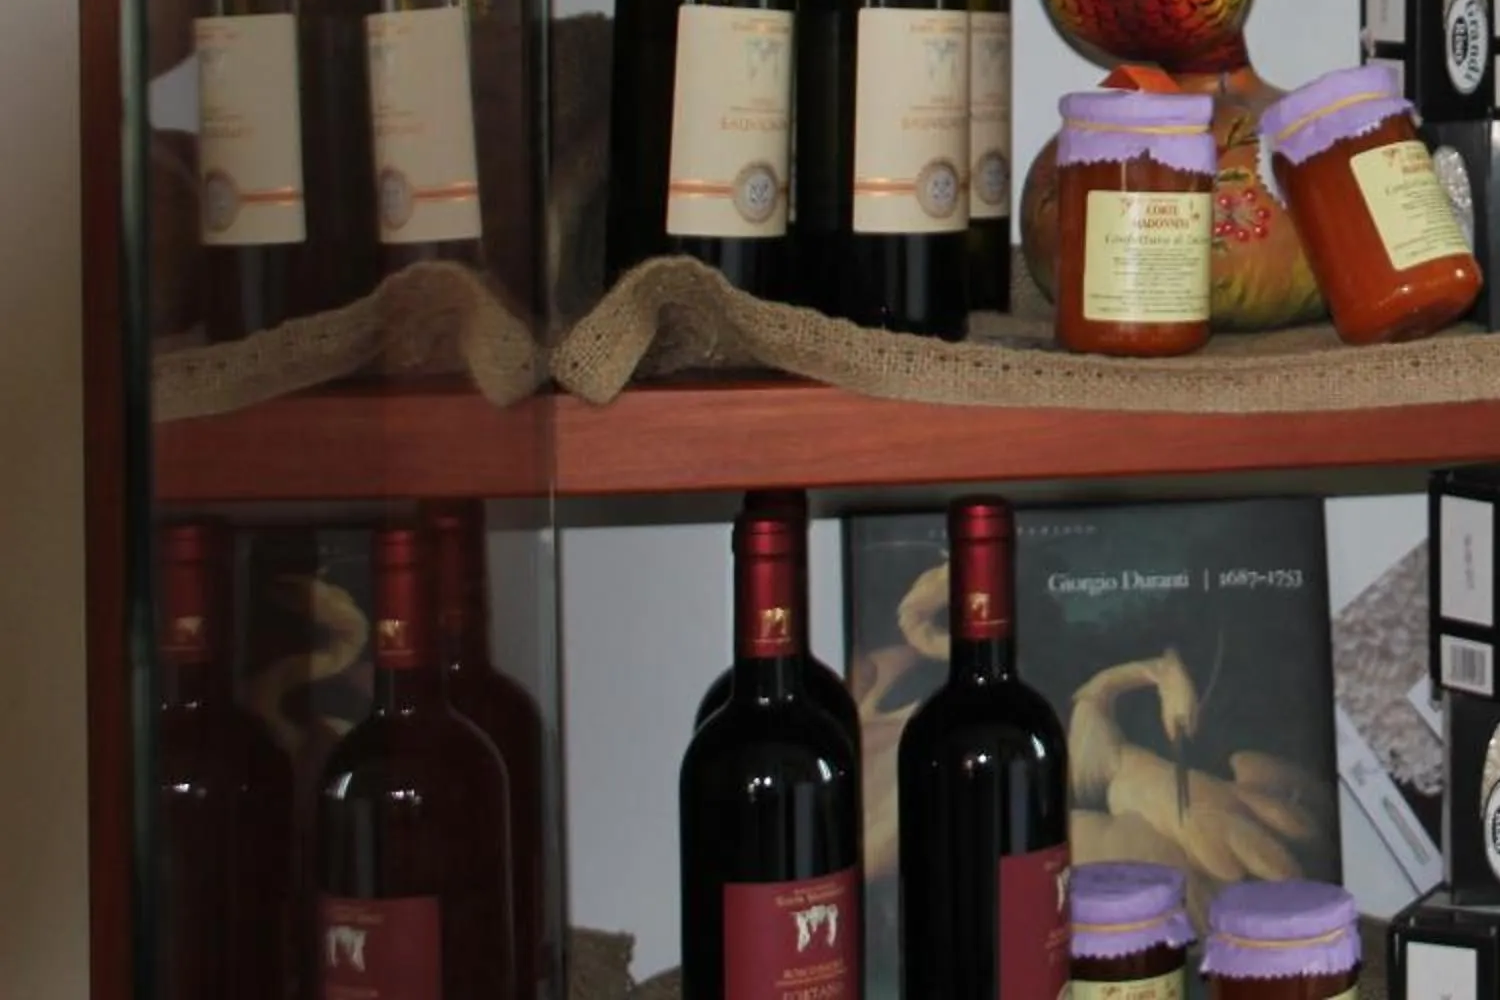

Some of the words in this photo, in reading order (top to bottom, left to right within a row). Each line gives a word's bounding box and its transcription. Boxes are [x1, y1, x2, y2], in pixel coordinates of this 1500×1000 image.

[1048, 571, 1118, 597] Giorgio
[1121, 569, 1191, 592] Duranti
[1218, 568, 1303, 588] 1687-1753
